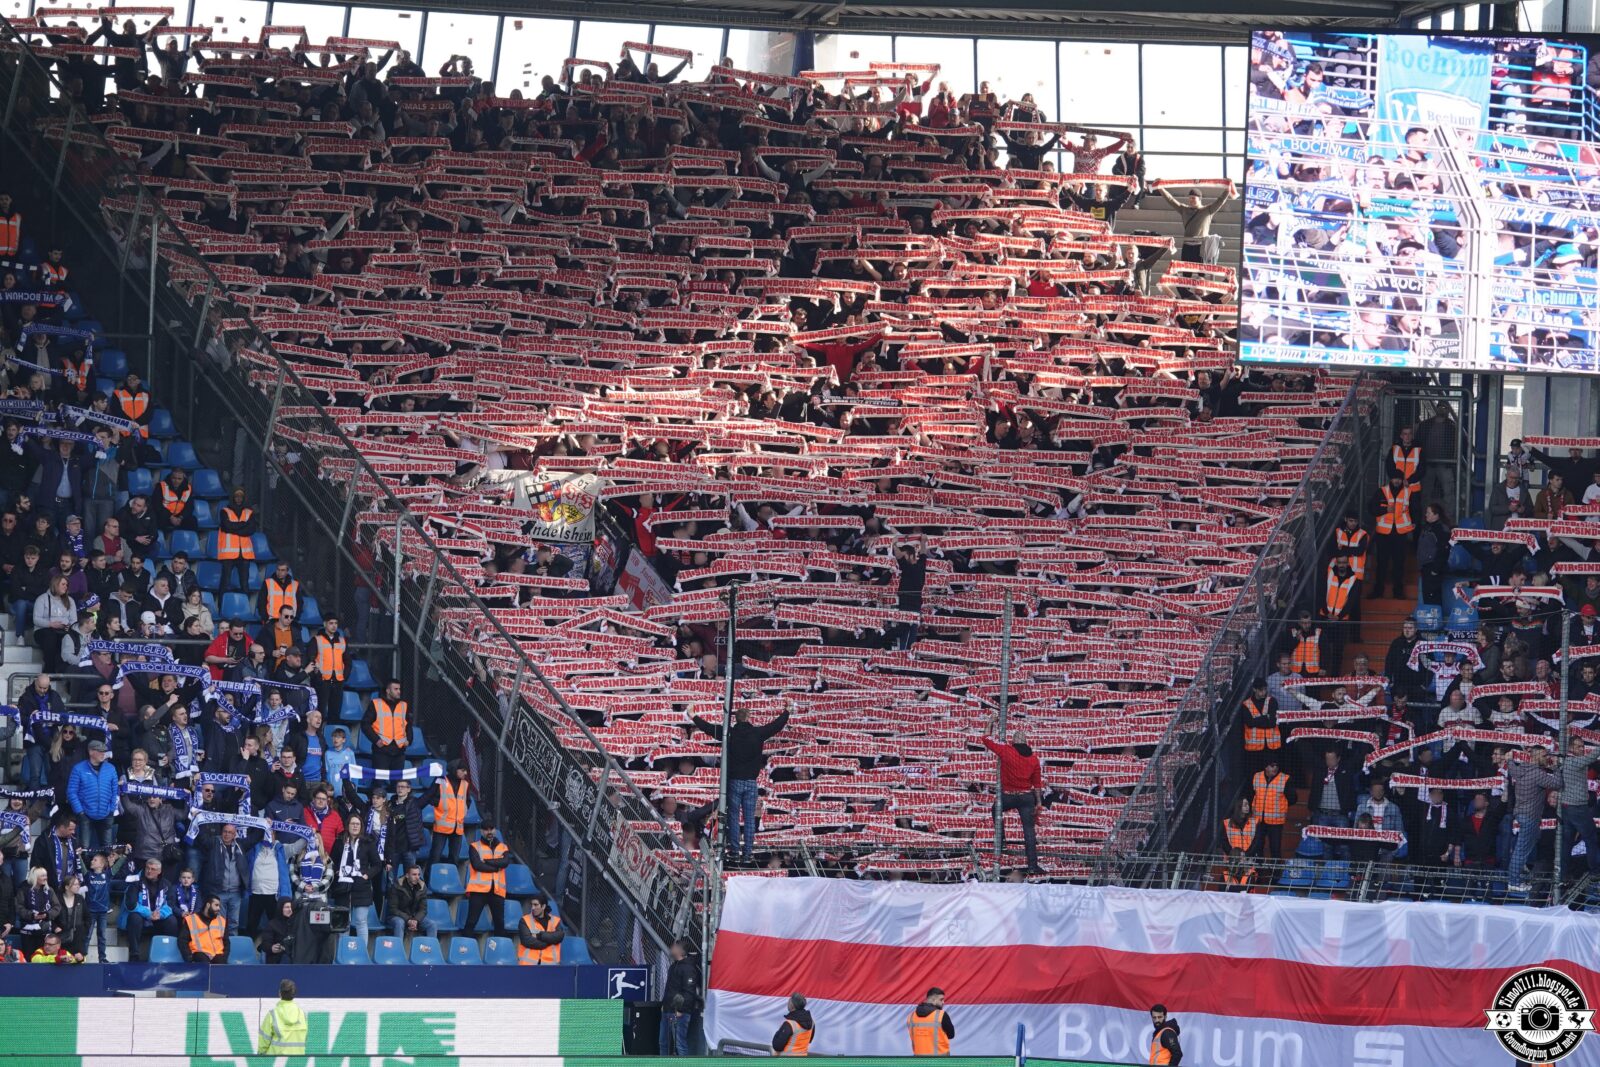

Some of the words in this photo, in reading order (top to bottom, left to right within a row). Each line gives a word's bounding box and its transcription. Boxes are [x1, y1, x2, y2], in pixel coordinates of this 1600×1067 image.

[88, 411, 130, 428] BOCHUM
[46, 429, 94, 441] BOCHUM
[88, 641, 125, 650] STOLZES
[127, 644, 168, 656] MITGLIED
[140, 663, 181, 673] BOCHUM
[204, 773, 243, 784] BOCHUM
